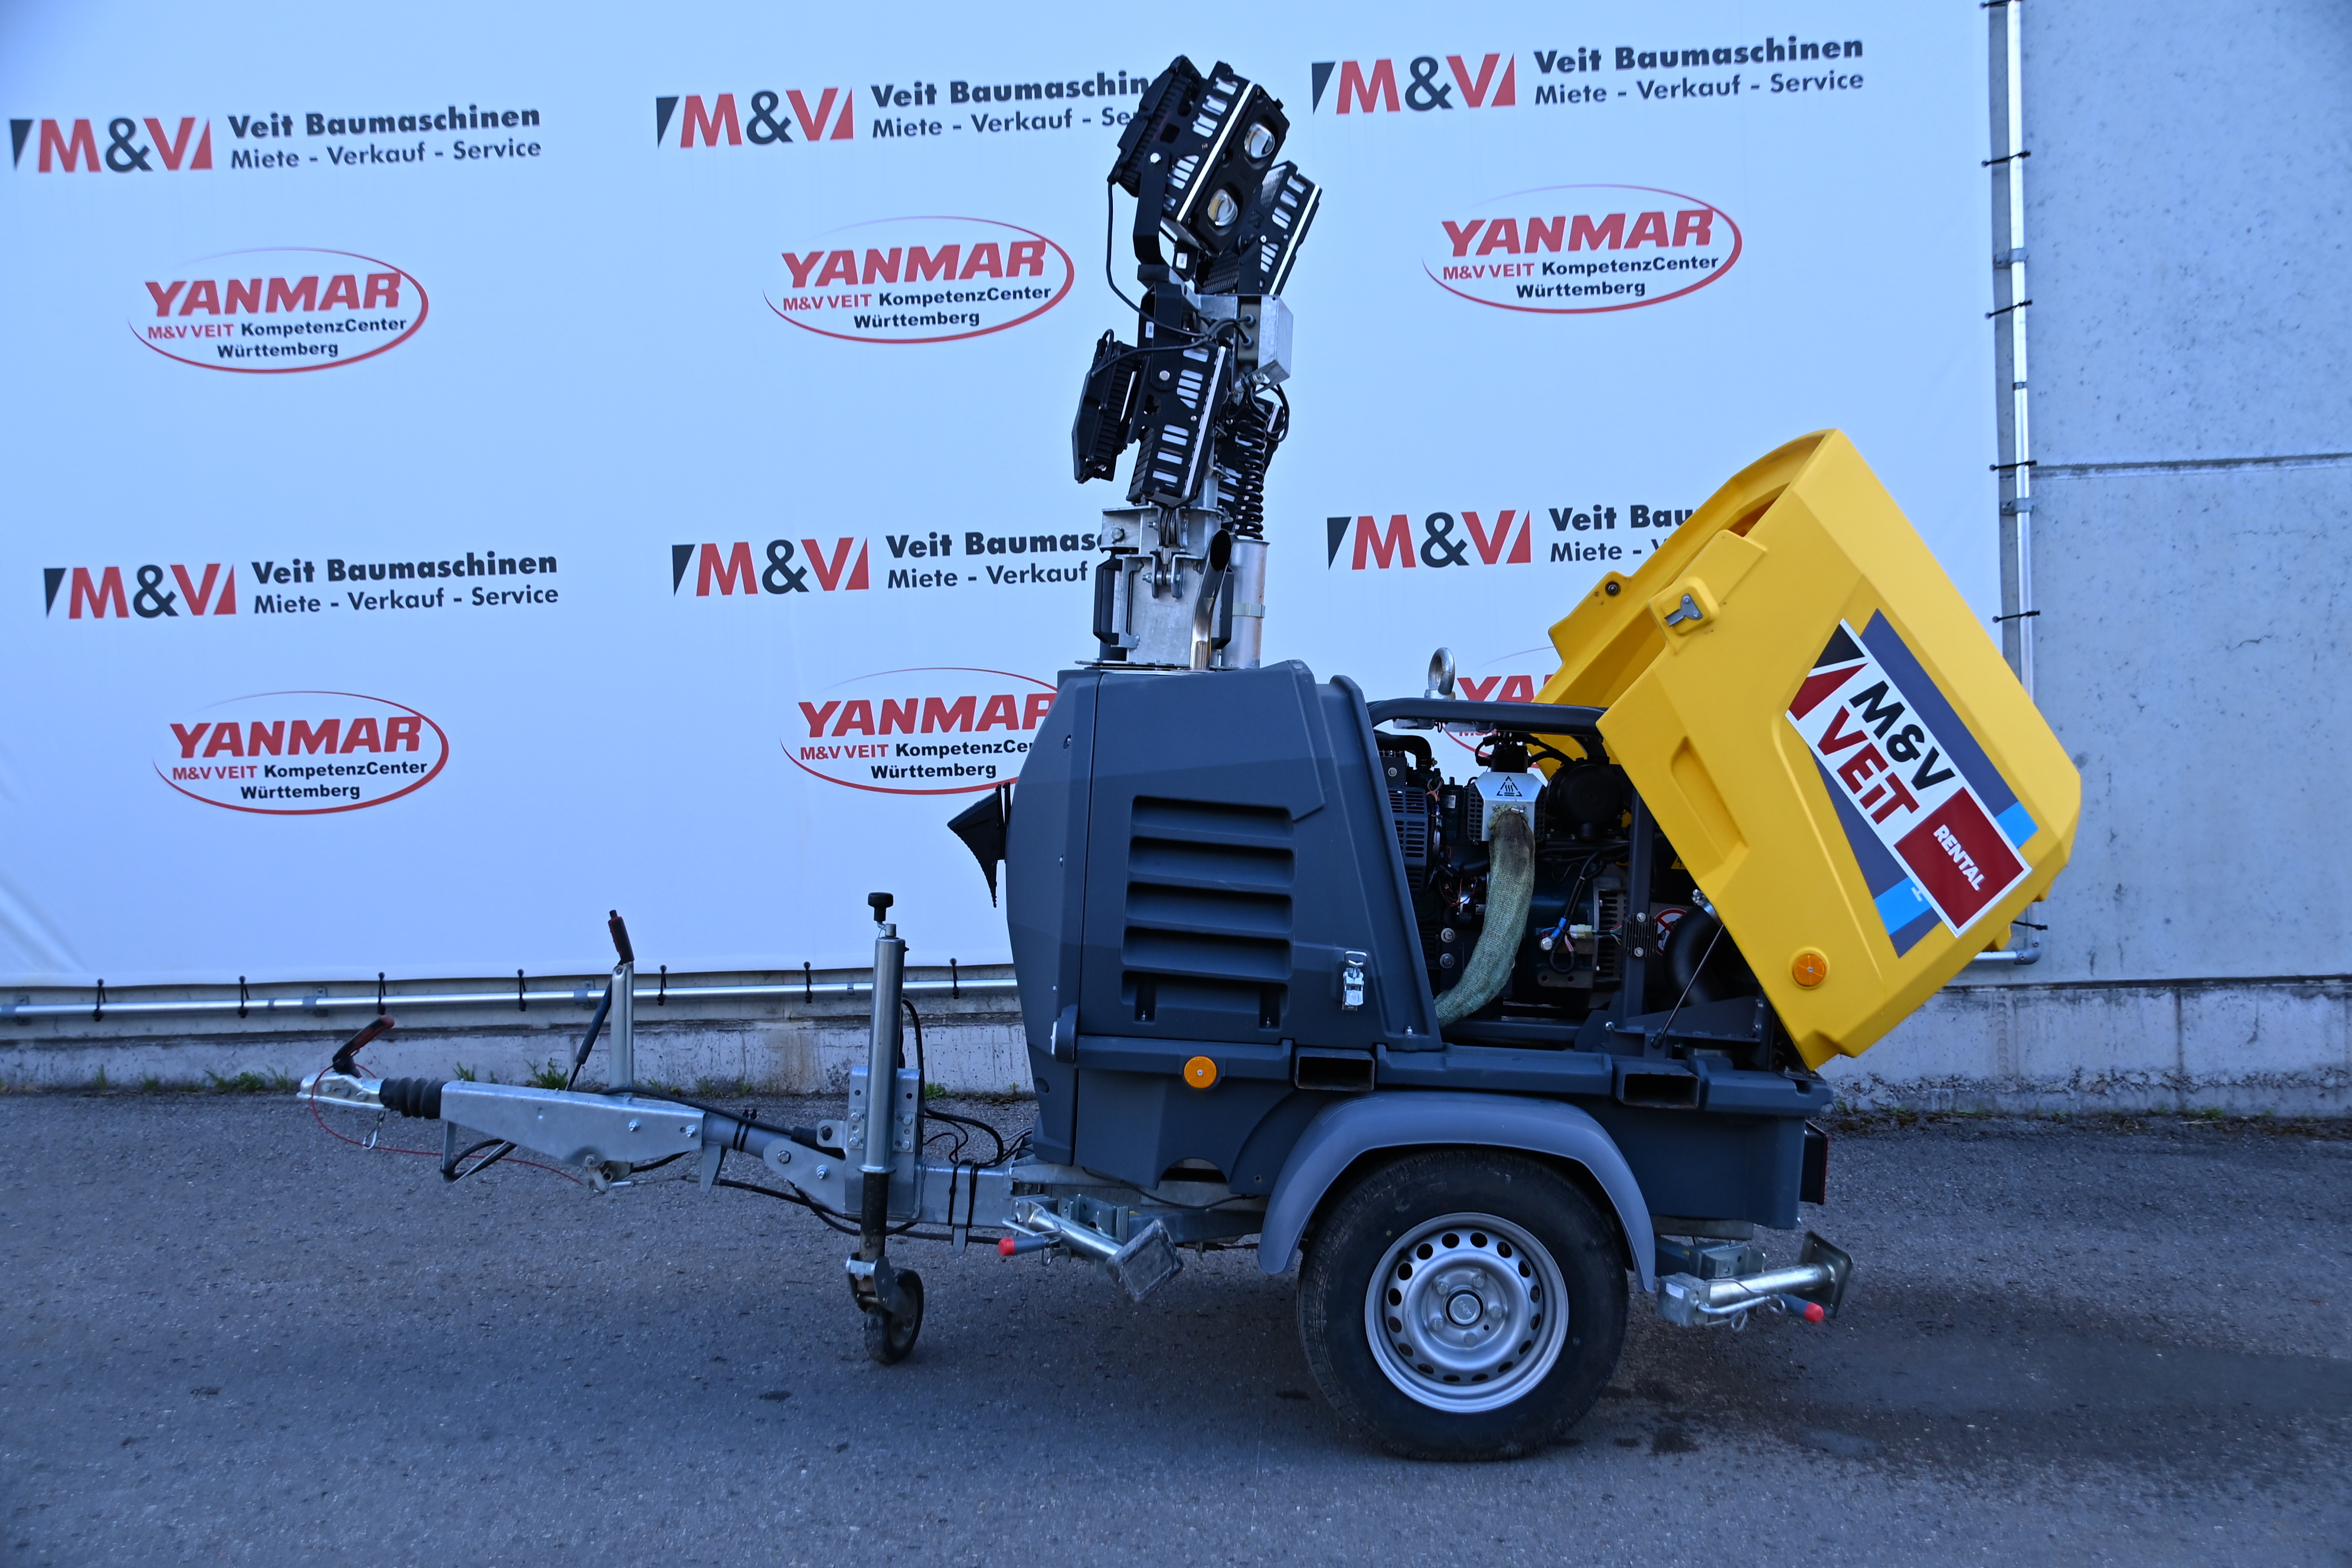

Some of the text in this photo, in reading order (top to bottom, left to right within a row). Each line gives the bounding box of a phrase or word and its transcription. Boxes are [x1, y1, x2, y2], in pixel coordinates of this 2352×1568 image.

[1534, 36, 1863, 74] Veit Baumaschinen
[871, 70, 1149, 107] Veit Baumaschin
[1335, 53, 1501, 115] M&V
[1536, 84, 1606, 104] Miete
[1636, 74, 1740, 99] Verkauf
[1770, 70, 1863, 93] Service
[228, 104, 540, 138] Veit Baumaschinen
[680, 88, 837, 148] M&V
[873, 117, 942, 138] Miete
[971, 108, 1072, 132] Verkauf
[38, 117, 196, 173] M&V
[231, 149, 299, 169] Miete
[326, 142, 425, 165] Verkauf
[454, 138, 541, 159] Service
[1442, 210, 1714, 257] YANMAR
[781, 241, 1045, 288] YANMAR
[1443, 256, 1719, 280] M&V VEIT KompetenzCenter
[145, 273, 401, 317] YANMAR
[783, 288, 1051, 311] M&V VEIT KompetenzCenter
[1516, 282, 1646, 299] Württemberg
[148, 318, 407, 339] M&V VEIT KompetenzCenter
[854, 311, 980, 327] Württemberg
[217, 342, 338, 358] Württemberg
[1549, 505, 1616, 531] Veit
[886, 532, 1102, 558] Veit Baumas
[1352, 510, 1516, 570] M&V
[1550, 541, 1622, 562] Miete
[251, 551, 557, 584] Veit Baumaschinen
[696, 537, 854, 596] M&V
[888, 569, 958, 589] Miete
[986, 561, 1087, 584] Verkauf
[69, 563, 221, 619] M&V
[254, 594, 321, 614] Miete
[348, 587, 444, 610] Verkauf
[472, 584, 558, 606] Service
[169, 716, 421, 758] YANMAR
[801, 739, 1033, 760] M&V VEIT KompetenzCe
[1848, 680, 1955, 790] M&V
[173, 762, 427, 780] M&V VEIT KompetenzCenter
[871, 763, 996, 779] Württemberg
[240, 785, 361, 801] Württemberg
[1933, 825, 1985, 891] RENTAL
